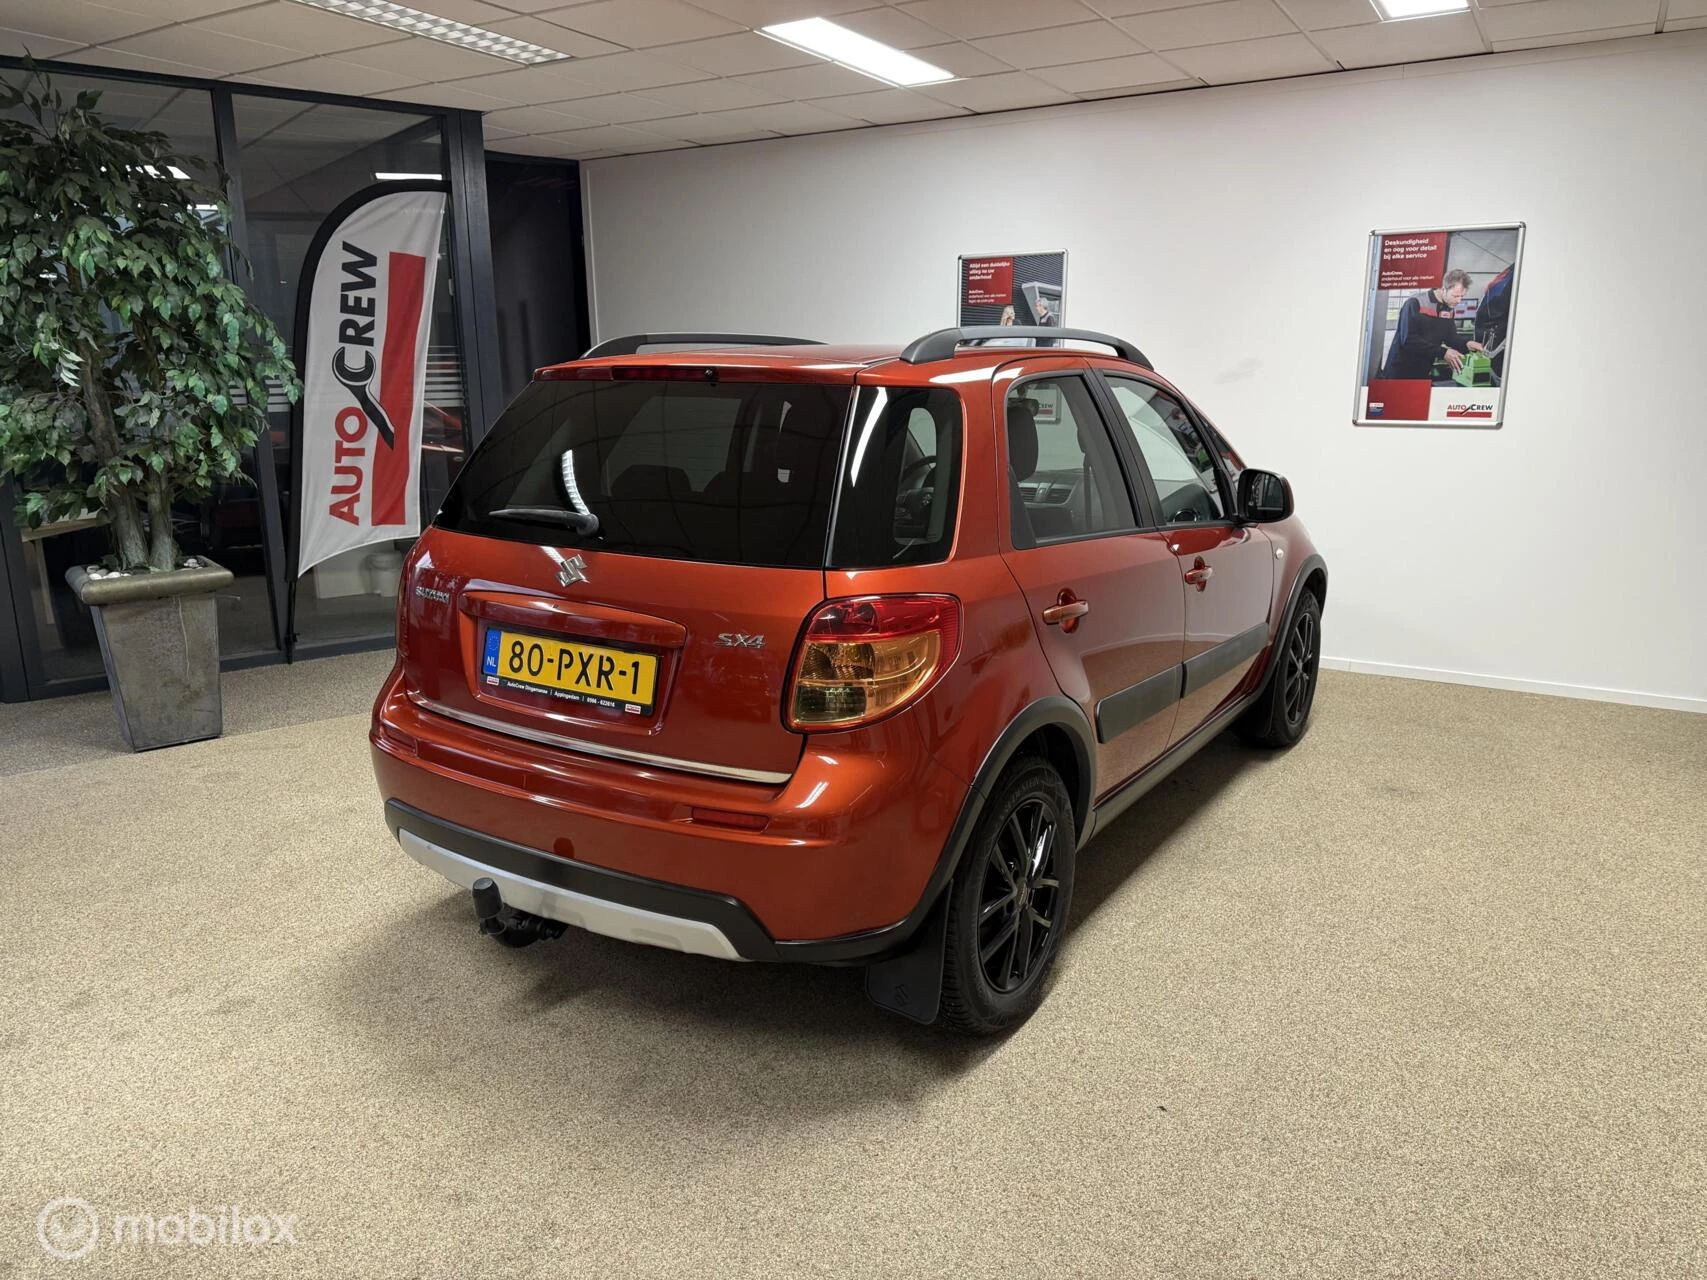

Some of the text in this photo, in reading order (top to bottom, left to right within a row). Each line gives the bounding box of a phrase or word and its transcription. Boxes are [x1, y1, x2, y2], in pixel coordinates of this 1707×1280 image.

[716, 633, 766, 649] SX4
[486, 655, 497, 668] NL
[508, 640, 640, 695] 80-PXR-1
